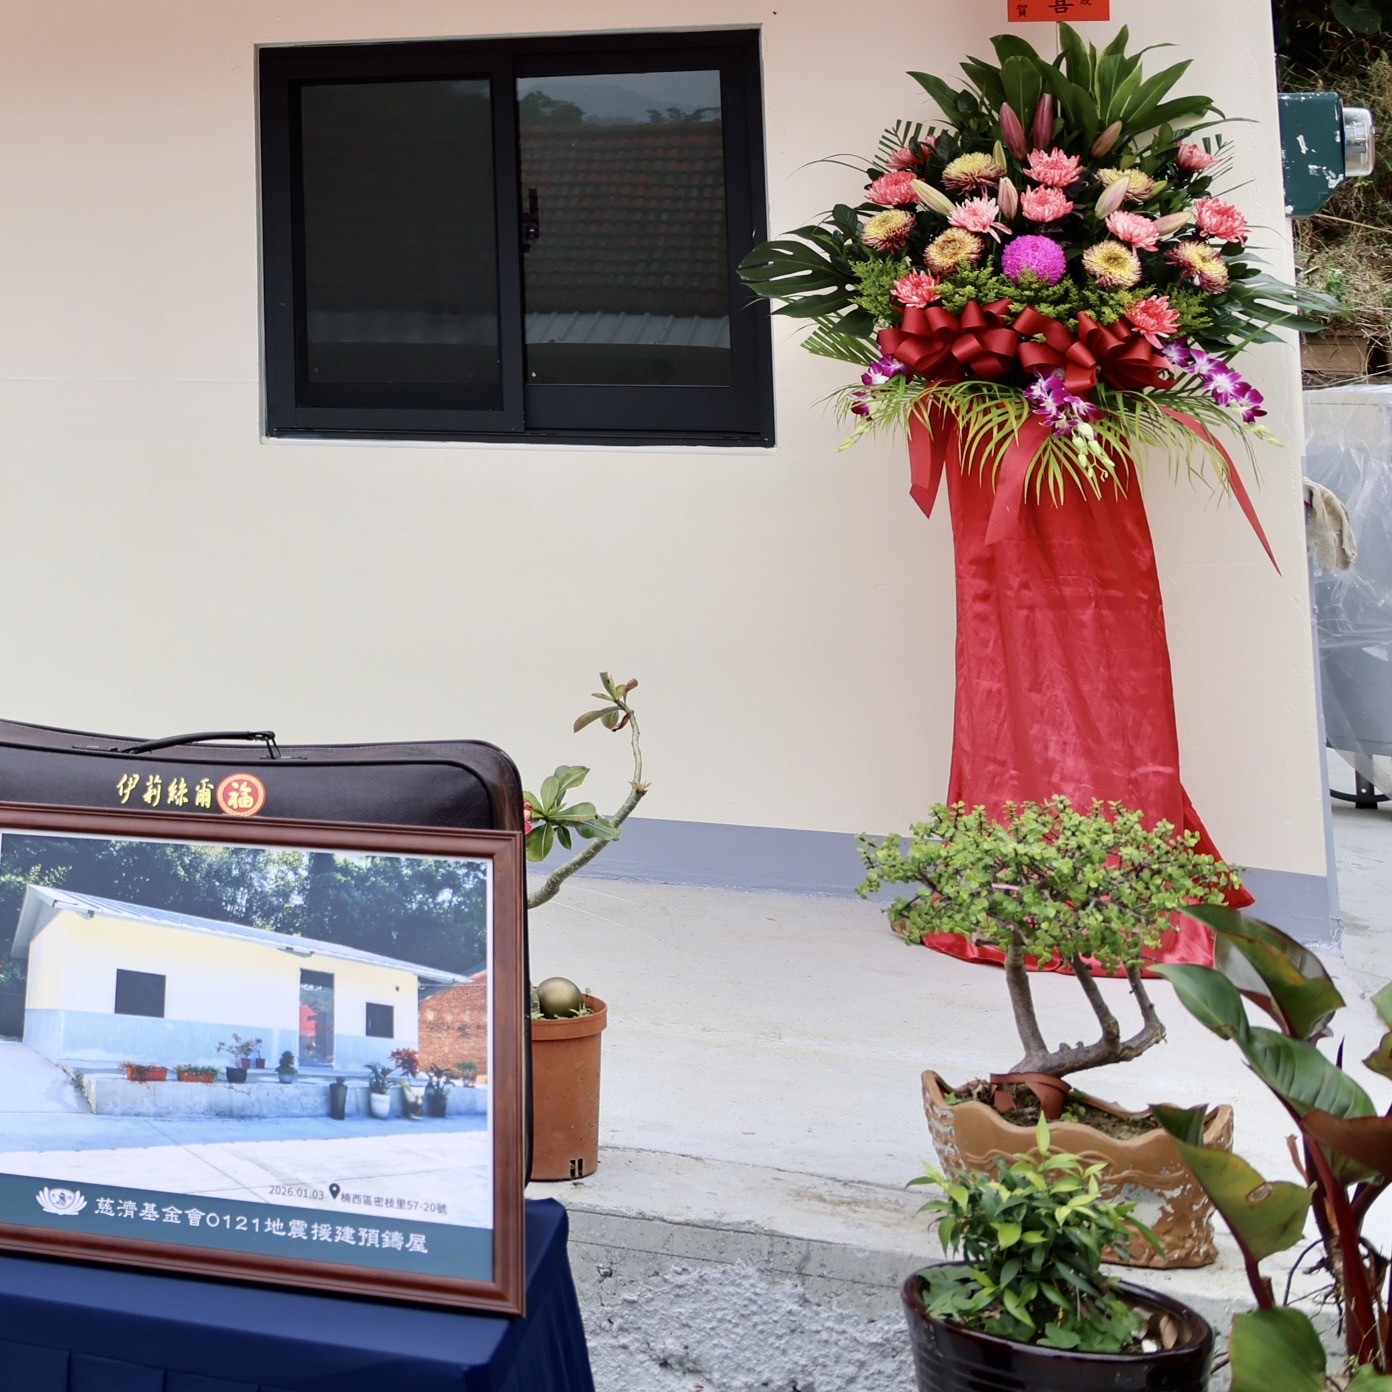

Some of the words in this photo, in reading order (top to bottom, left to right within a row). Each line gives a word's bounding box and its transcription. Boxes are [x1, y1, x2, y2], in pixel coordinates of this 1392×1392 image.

[269, 1185, 324, 1200] 2026.01.03
[94, 1197, 428, 1254] 慈濟基金會0121地震援建預鑄屋
